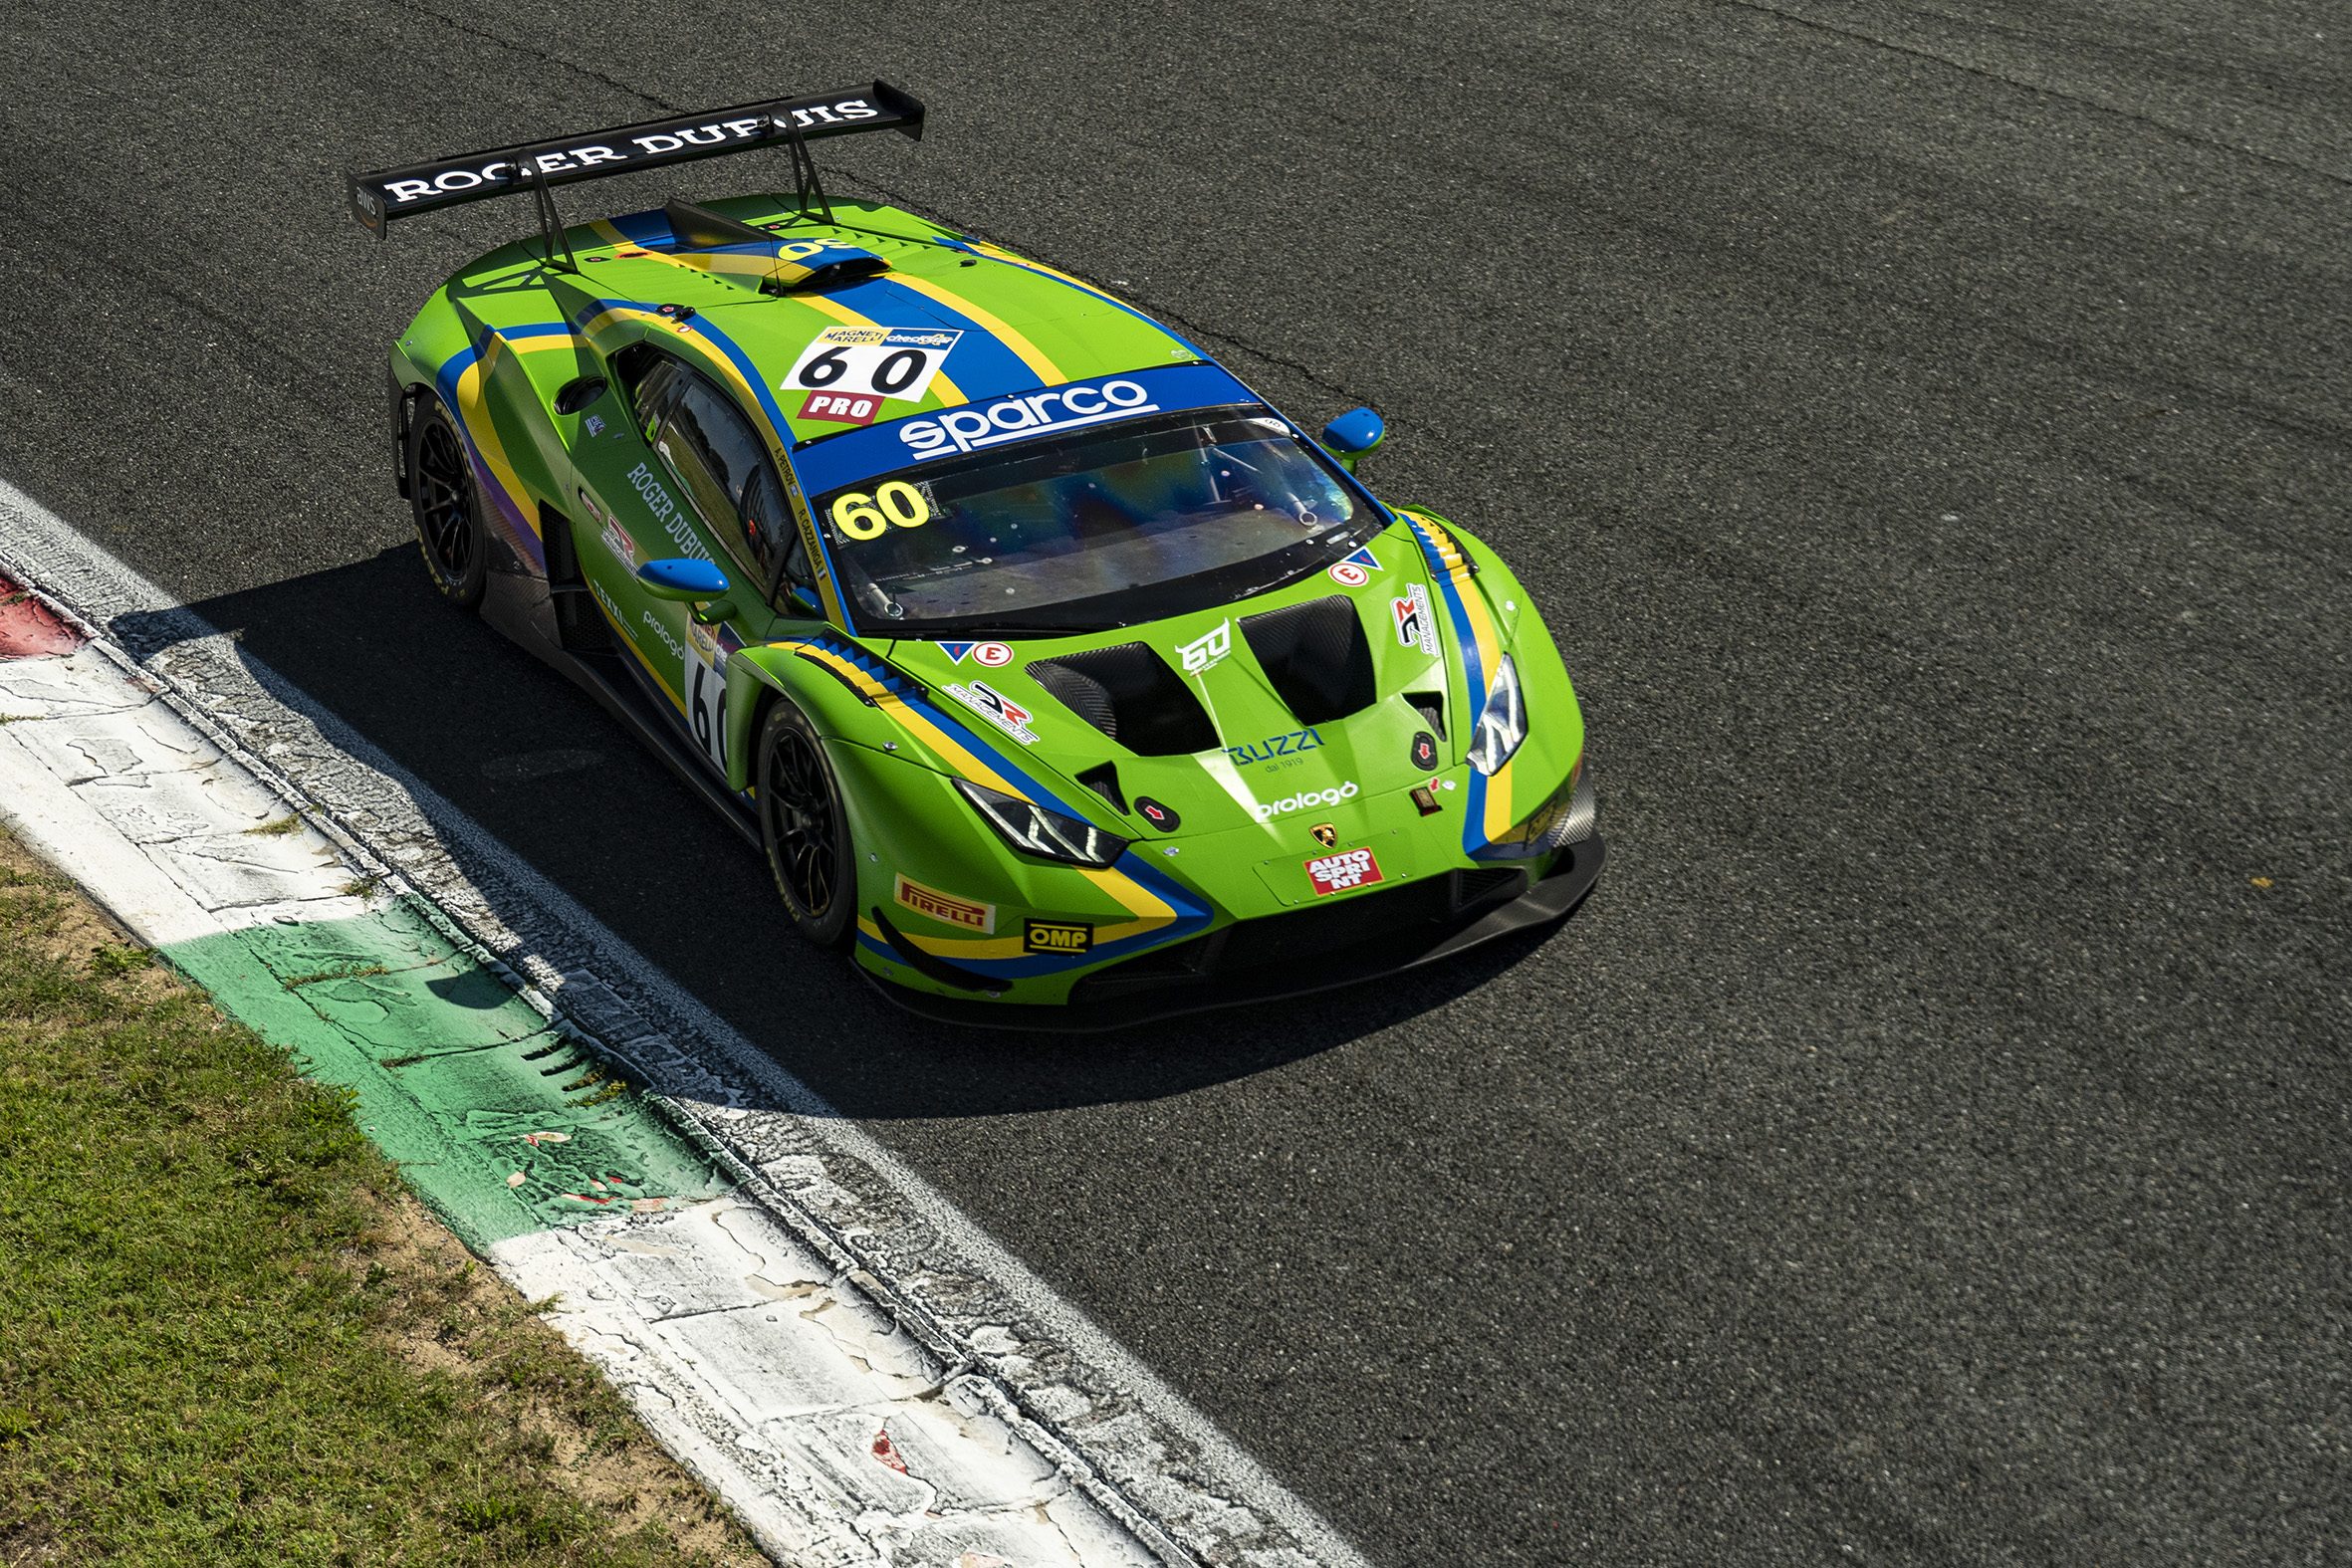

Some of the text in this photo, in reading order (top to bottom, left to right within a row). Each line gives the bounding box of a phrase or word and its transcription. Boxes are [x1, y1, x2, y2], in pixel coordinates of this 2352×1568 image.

[356, 186, 376, 216] aws
[809, 395, 873, 418] PRO
[899, 380, 1148, 453] sparco
[778, 454, 796, 487] PETROV
[626, 462, 675, 523] ROGER
[832, 481, 930, 541] 60
[1414, 586, 1433, 652] MANAGEMENTS
[950, 685, 1034, 743] MANAGEMENTS
[1222, 727, 1324, 767] BUZZI
[1265, 758, 1304, 774] dal 1919
[1309, 850, 1370, 873] AUTO
[1314, 860, 1371, 882] SPRI
[1330, 873, 1361, 889] NT
[901, 881, 986, 927] PIRELLI
[1030, 928, 1087, 948] OMP
